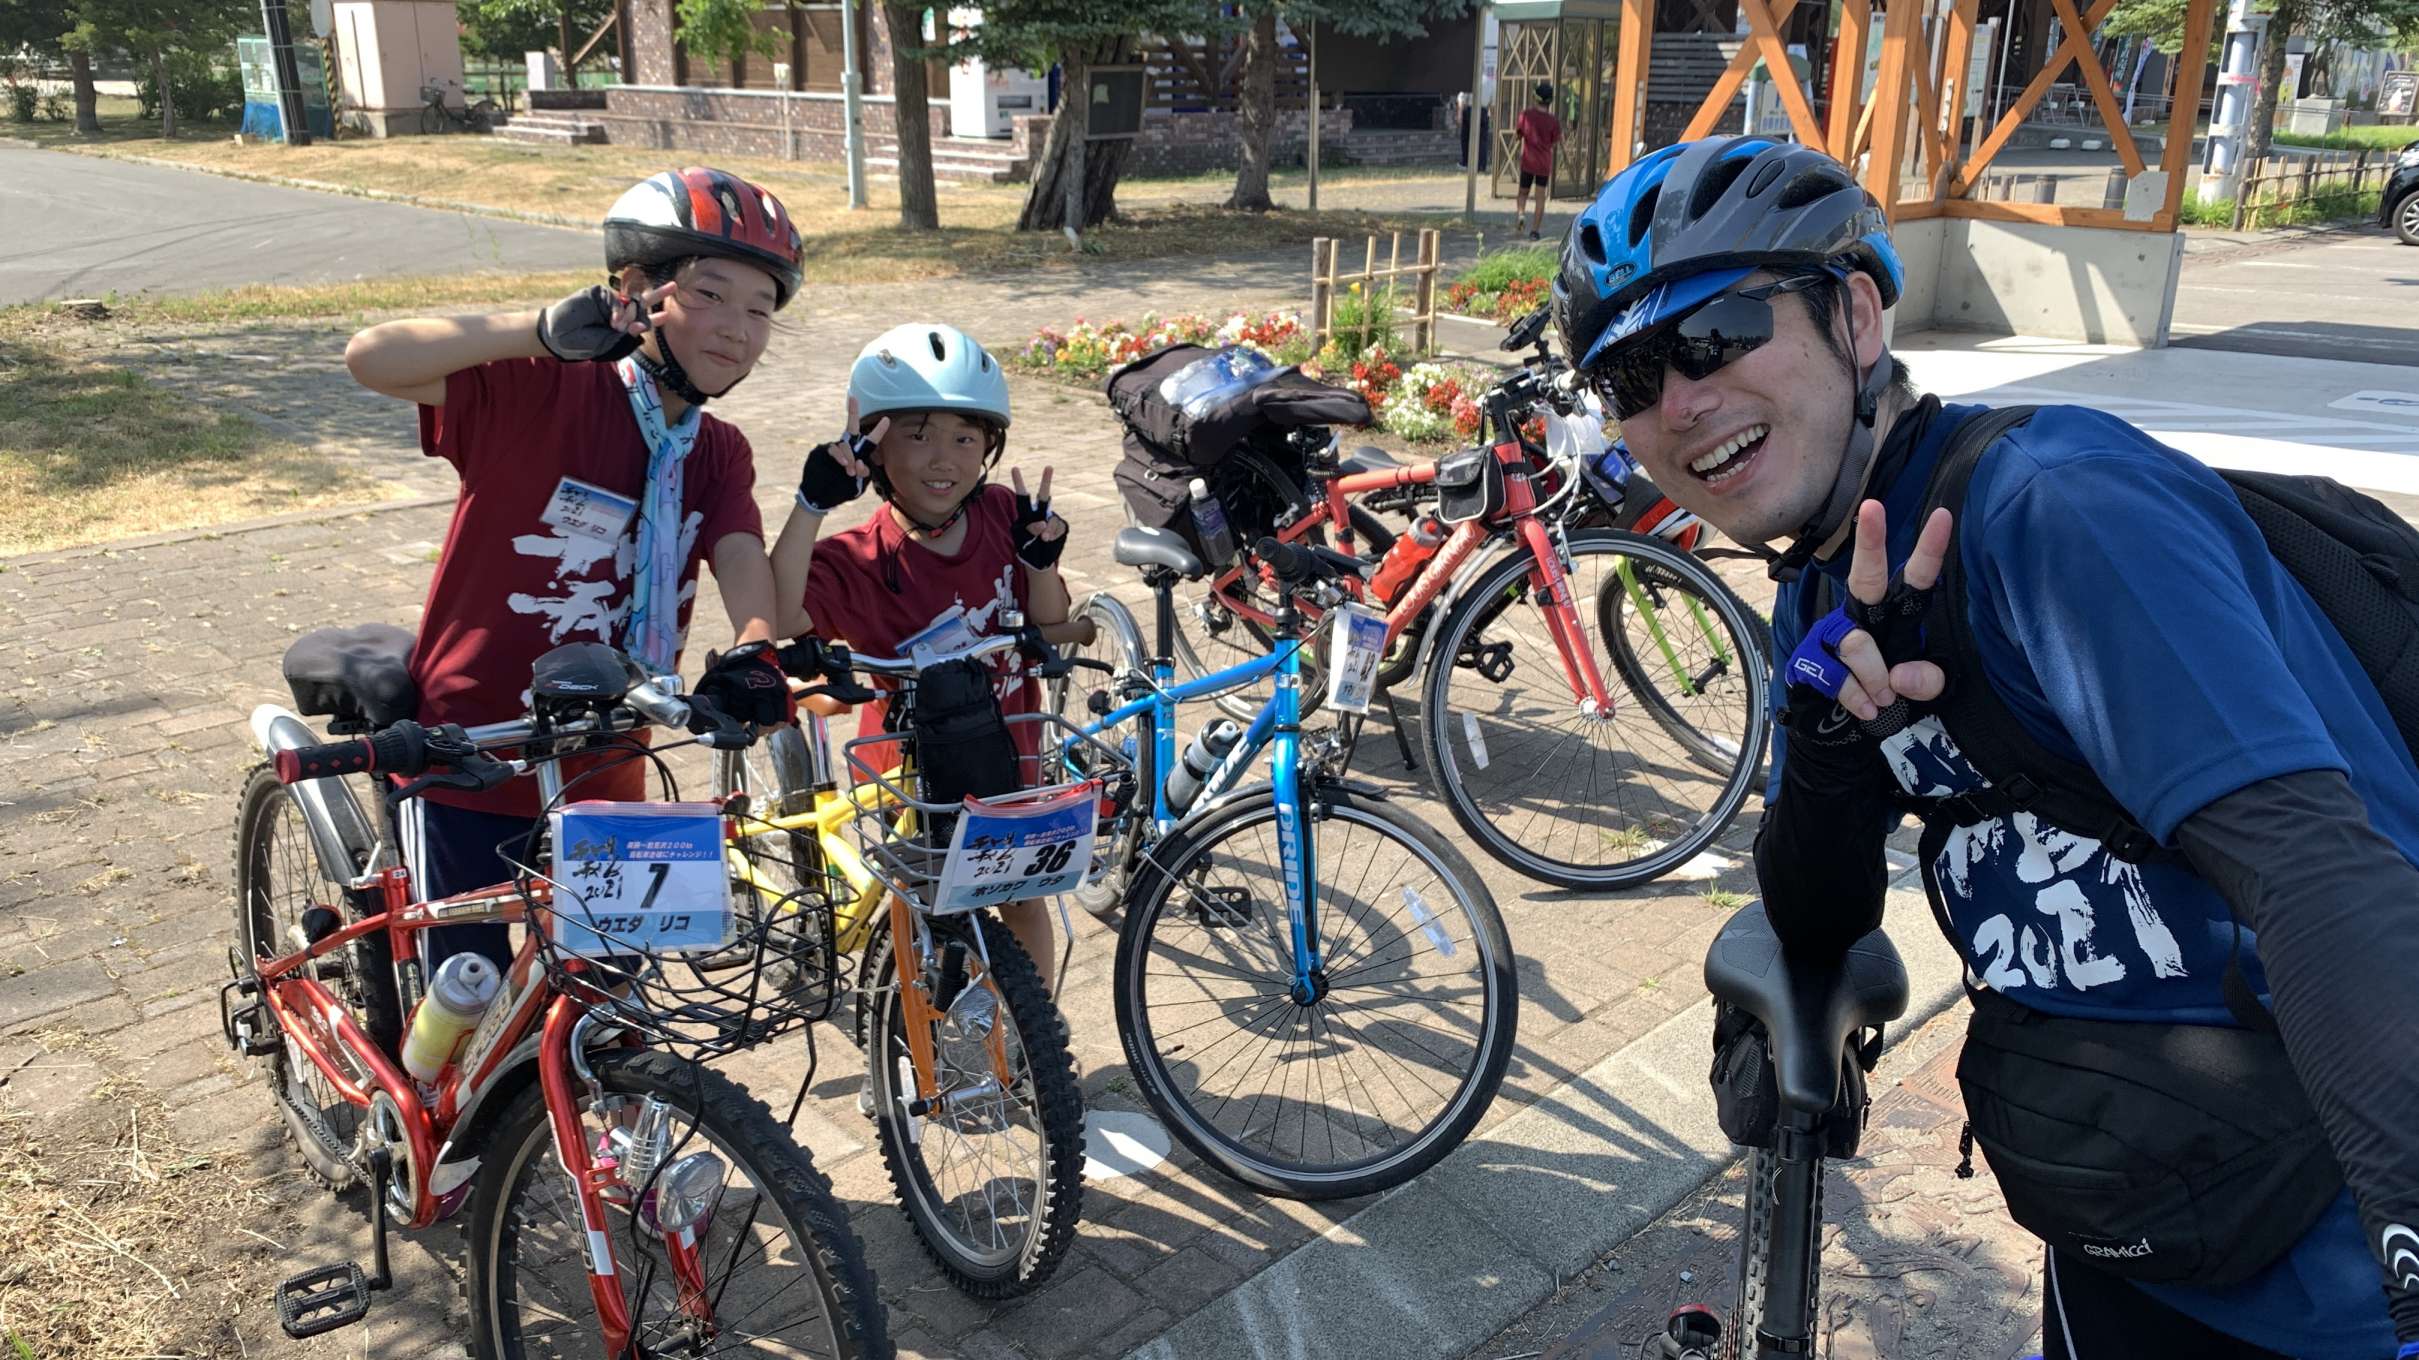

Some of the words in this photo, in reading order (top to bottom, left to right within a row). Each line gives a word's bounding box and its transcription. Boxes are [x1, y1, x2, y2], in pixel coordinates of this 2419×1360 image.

[1794, 657, 1831, 686] GEL
[974, 859, 1015, 877] 2021
[1024, 840, 1077, 876] 36
[585, 876, 624, 901] 2021
[640, 863, 671, 909] 7
[598, 916, 645, 933] ウエダ
[660, 916, 691, 932] リコ
